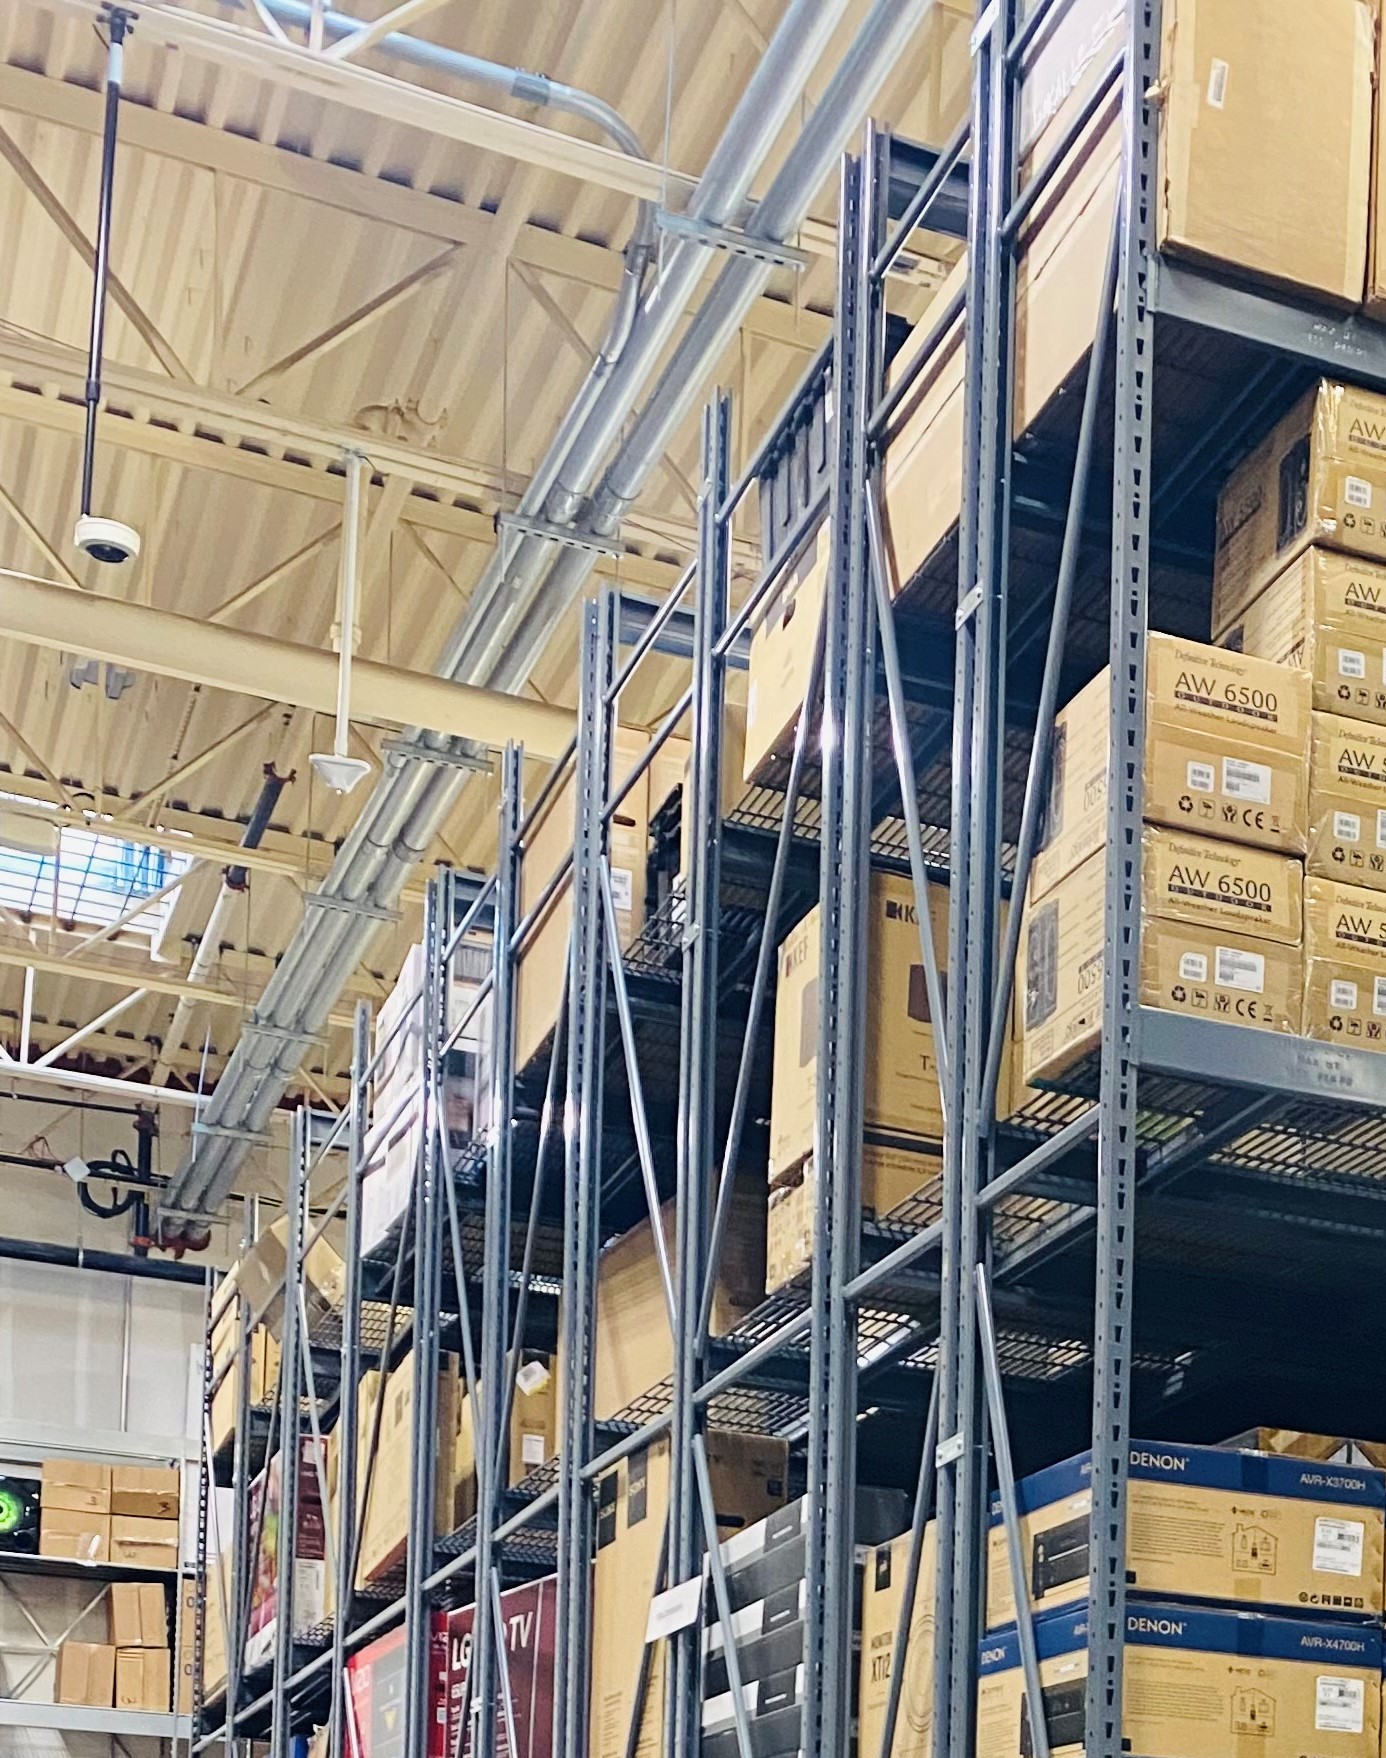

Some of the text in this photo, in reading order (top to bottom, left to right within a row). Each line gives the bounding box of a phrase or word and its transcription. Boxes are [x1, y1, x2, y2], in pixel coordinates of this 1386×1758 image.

[1350, 418, 1386, 441] AW
[1345, 582, 1381, 603] AW
[1175, 671, 1278, 712] AW 6500
[1339, 748, 1376, 770] AW
[1169, 864, 1271, 902] AW 6500
[1336, 913, 1372, 935] AW
[1129, 1451, 1366, 1491] DENON AVR-X3700H
[451, 1610, 534, 1672] LG TV
[1127, 1616, 1366, 1653] DENON AVR-X4700H
